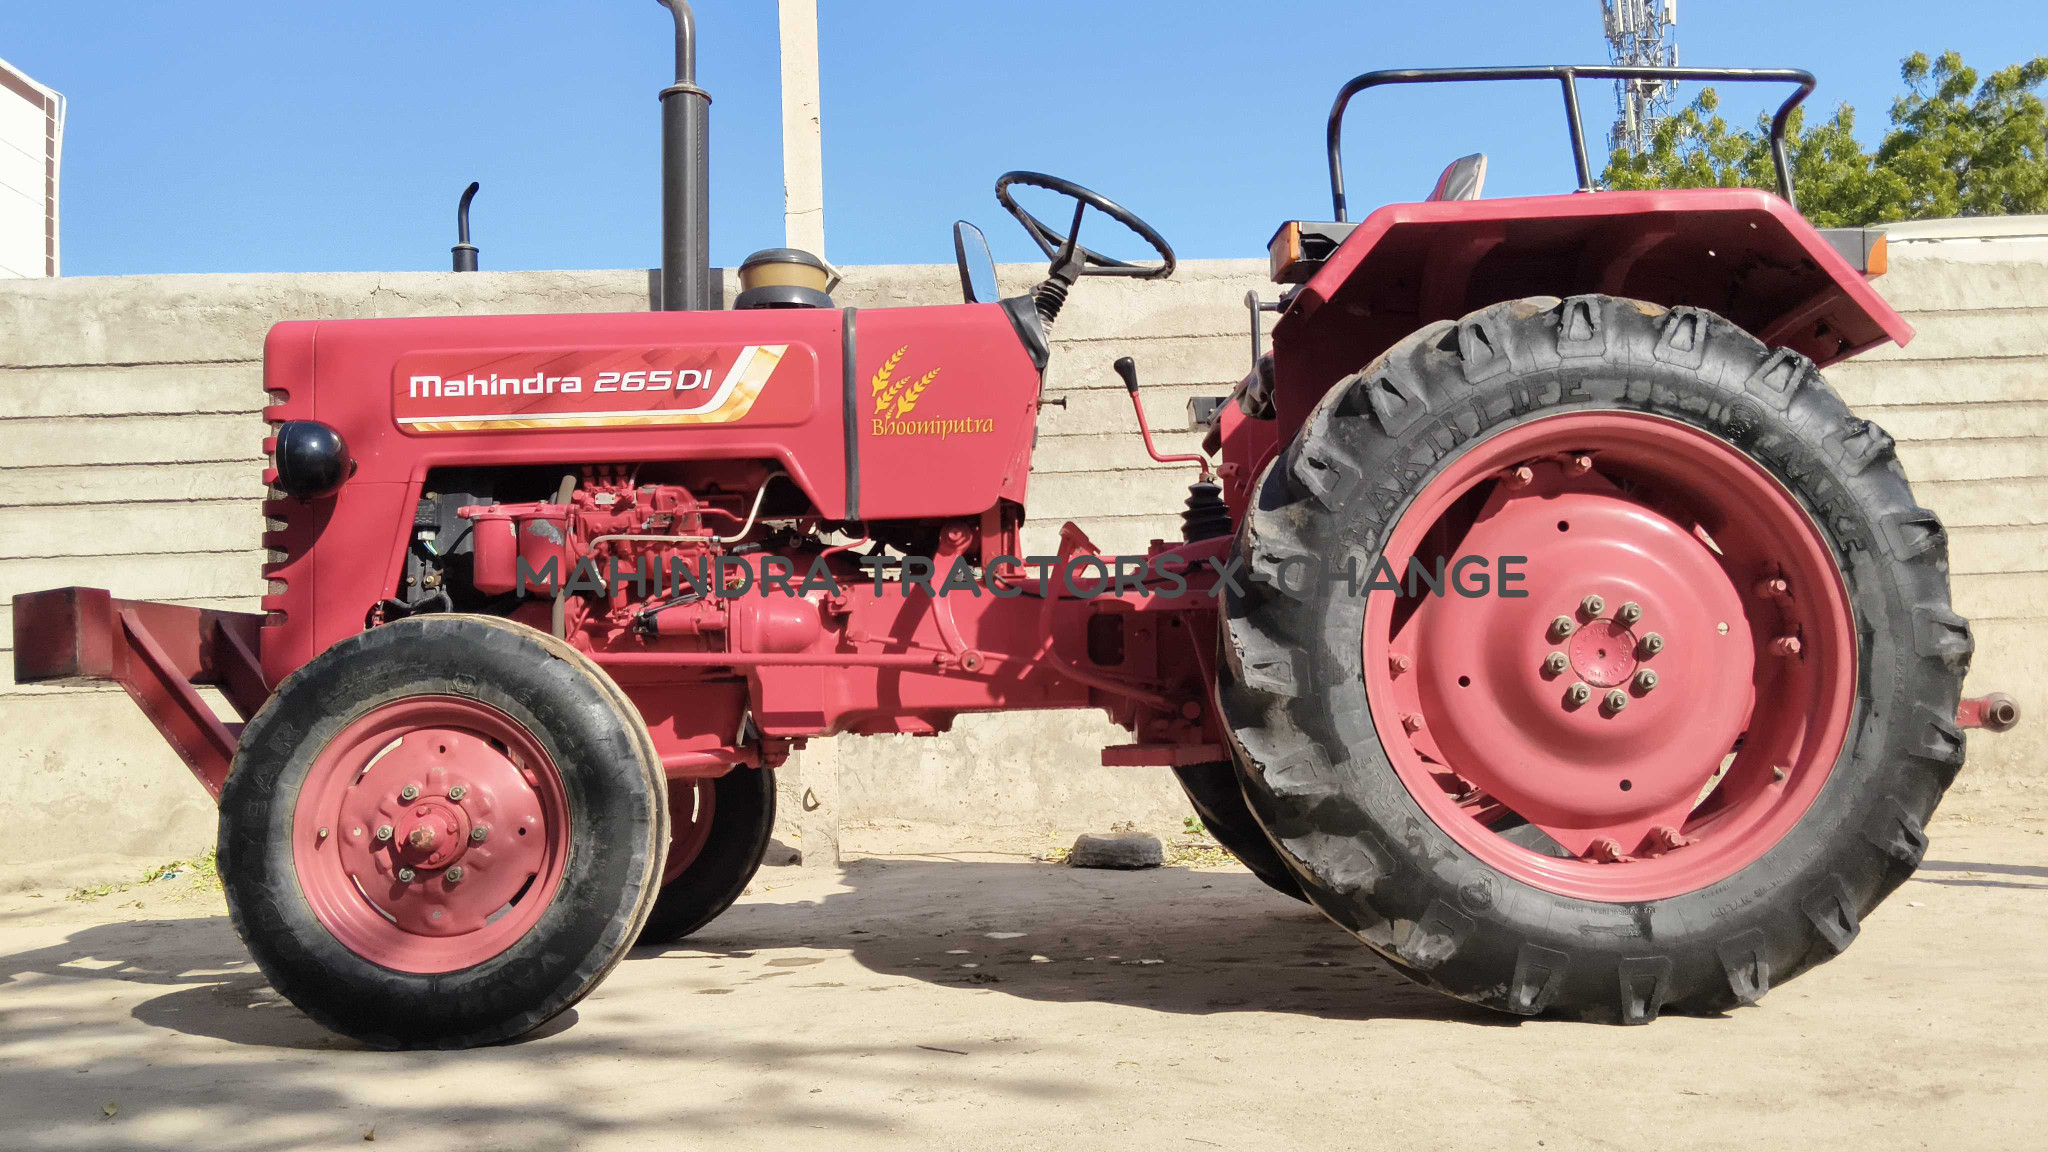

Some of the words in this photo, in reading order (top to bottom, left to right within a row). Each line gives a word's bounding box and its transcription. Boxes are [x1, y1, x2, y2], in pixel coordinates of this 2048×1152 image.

[410, 370, 582, 398] Mahindra
[1468, 366, 1592, 432] LIFE
[871, 415, 995, 441] Bhoomiputra
[1755, 432, 1881, 560] MRF
